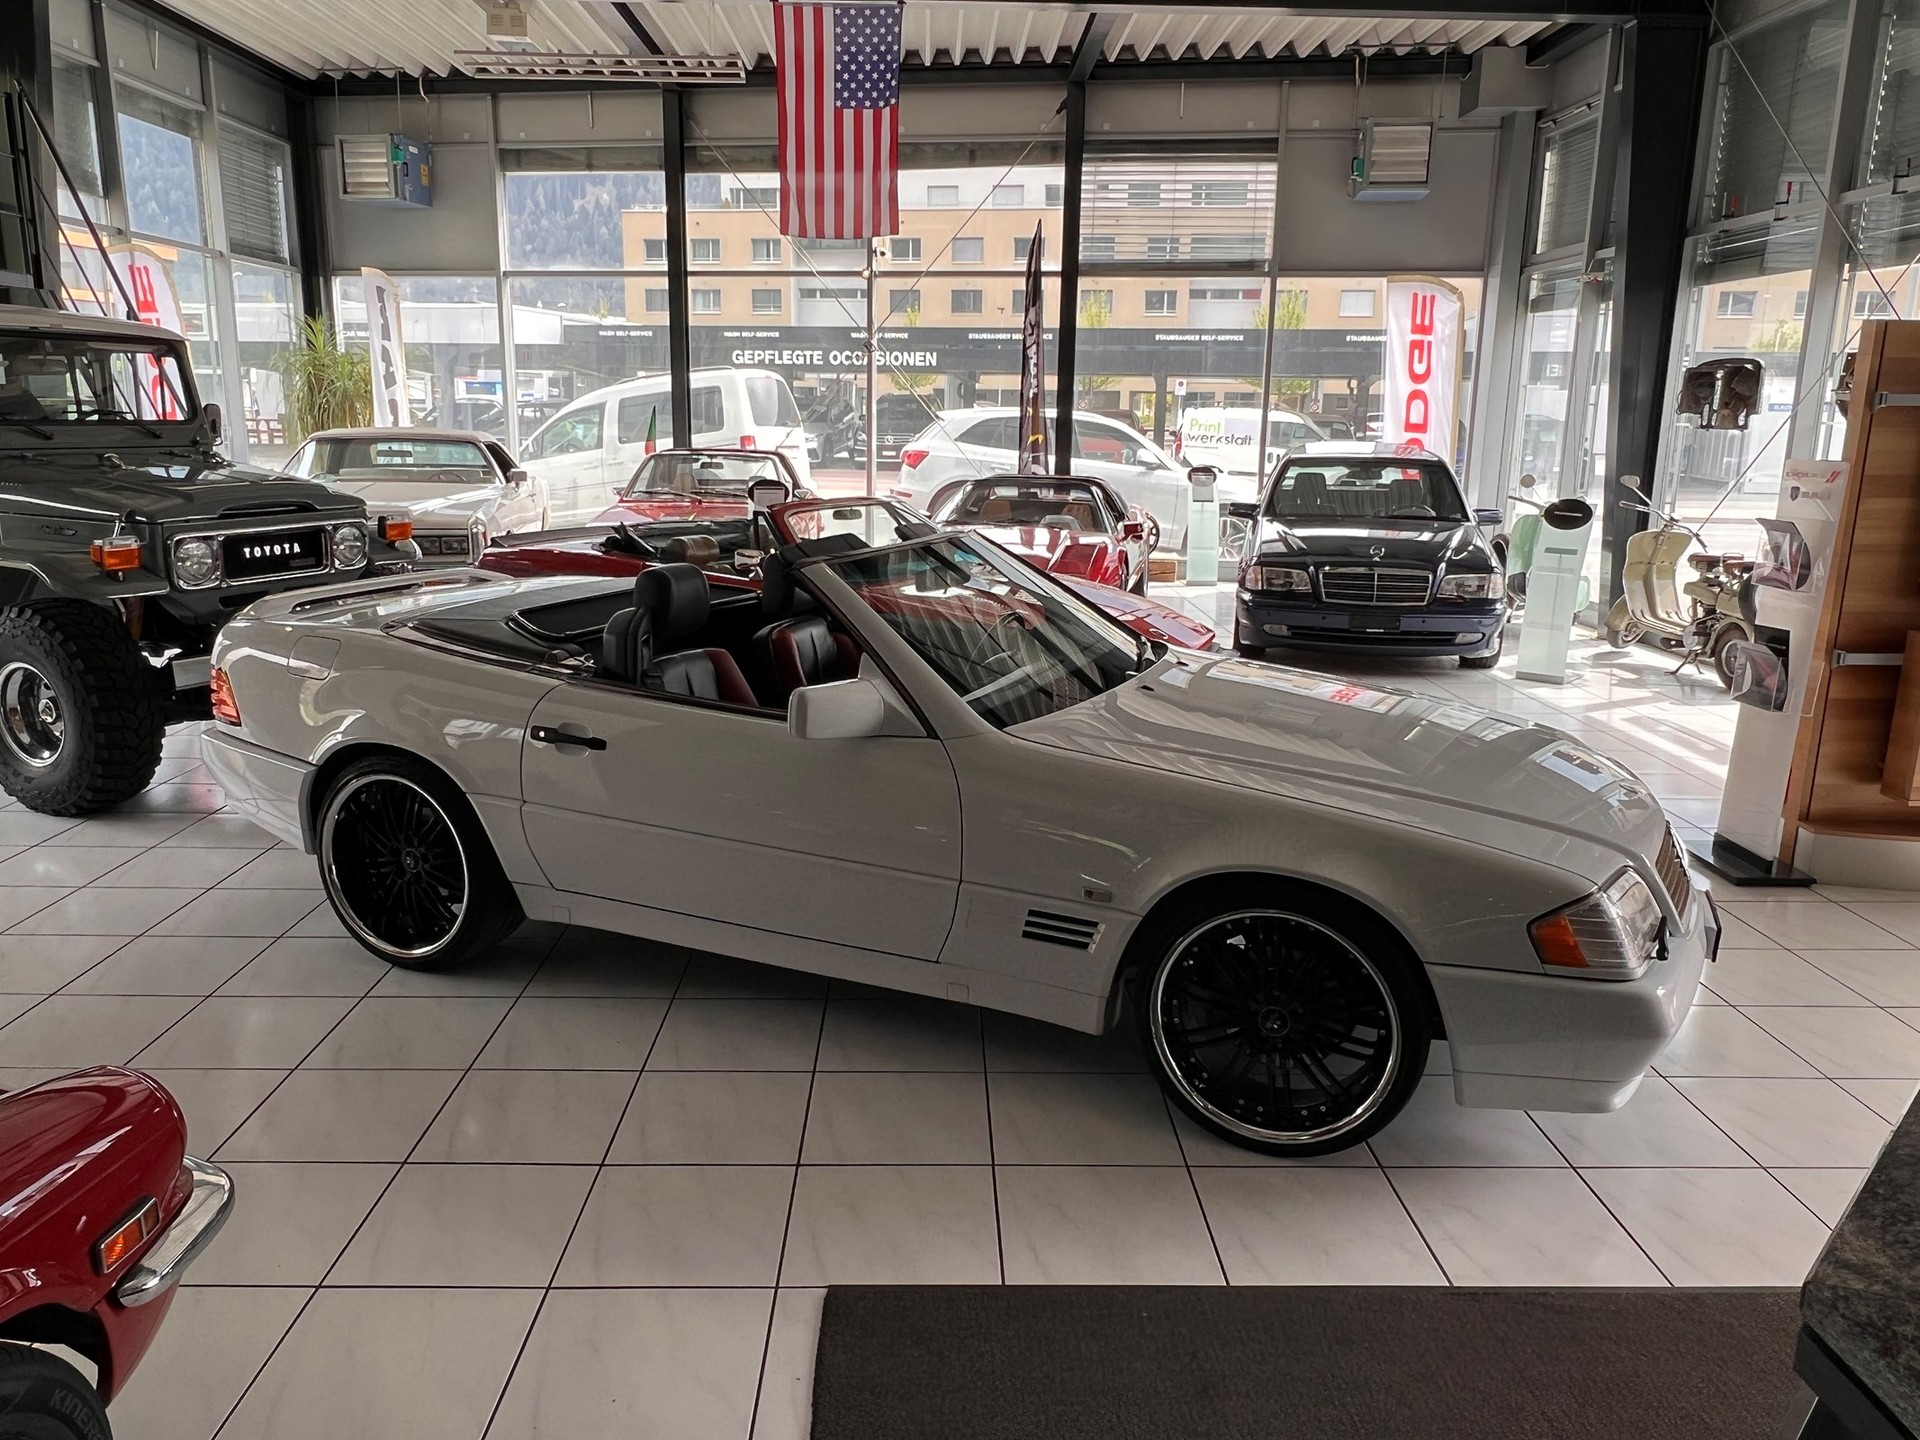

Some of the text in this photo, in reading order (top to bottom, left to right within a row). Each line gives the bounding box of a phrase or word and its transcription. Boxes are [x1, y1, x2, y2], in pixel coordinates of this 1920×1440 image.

[732, 349, 824, 365] GEPFLEGTE
[1187, 433, 1252, 446] werkstatt
[243, 542, 301, 559] TOYOTA
